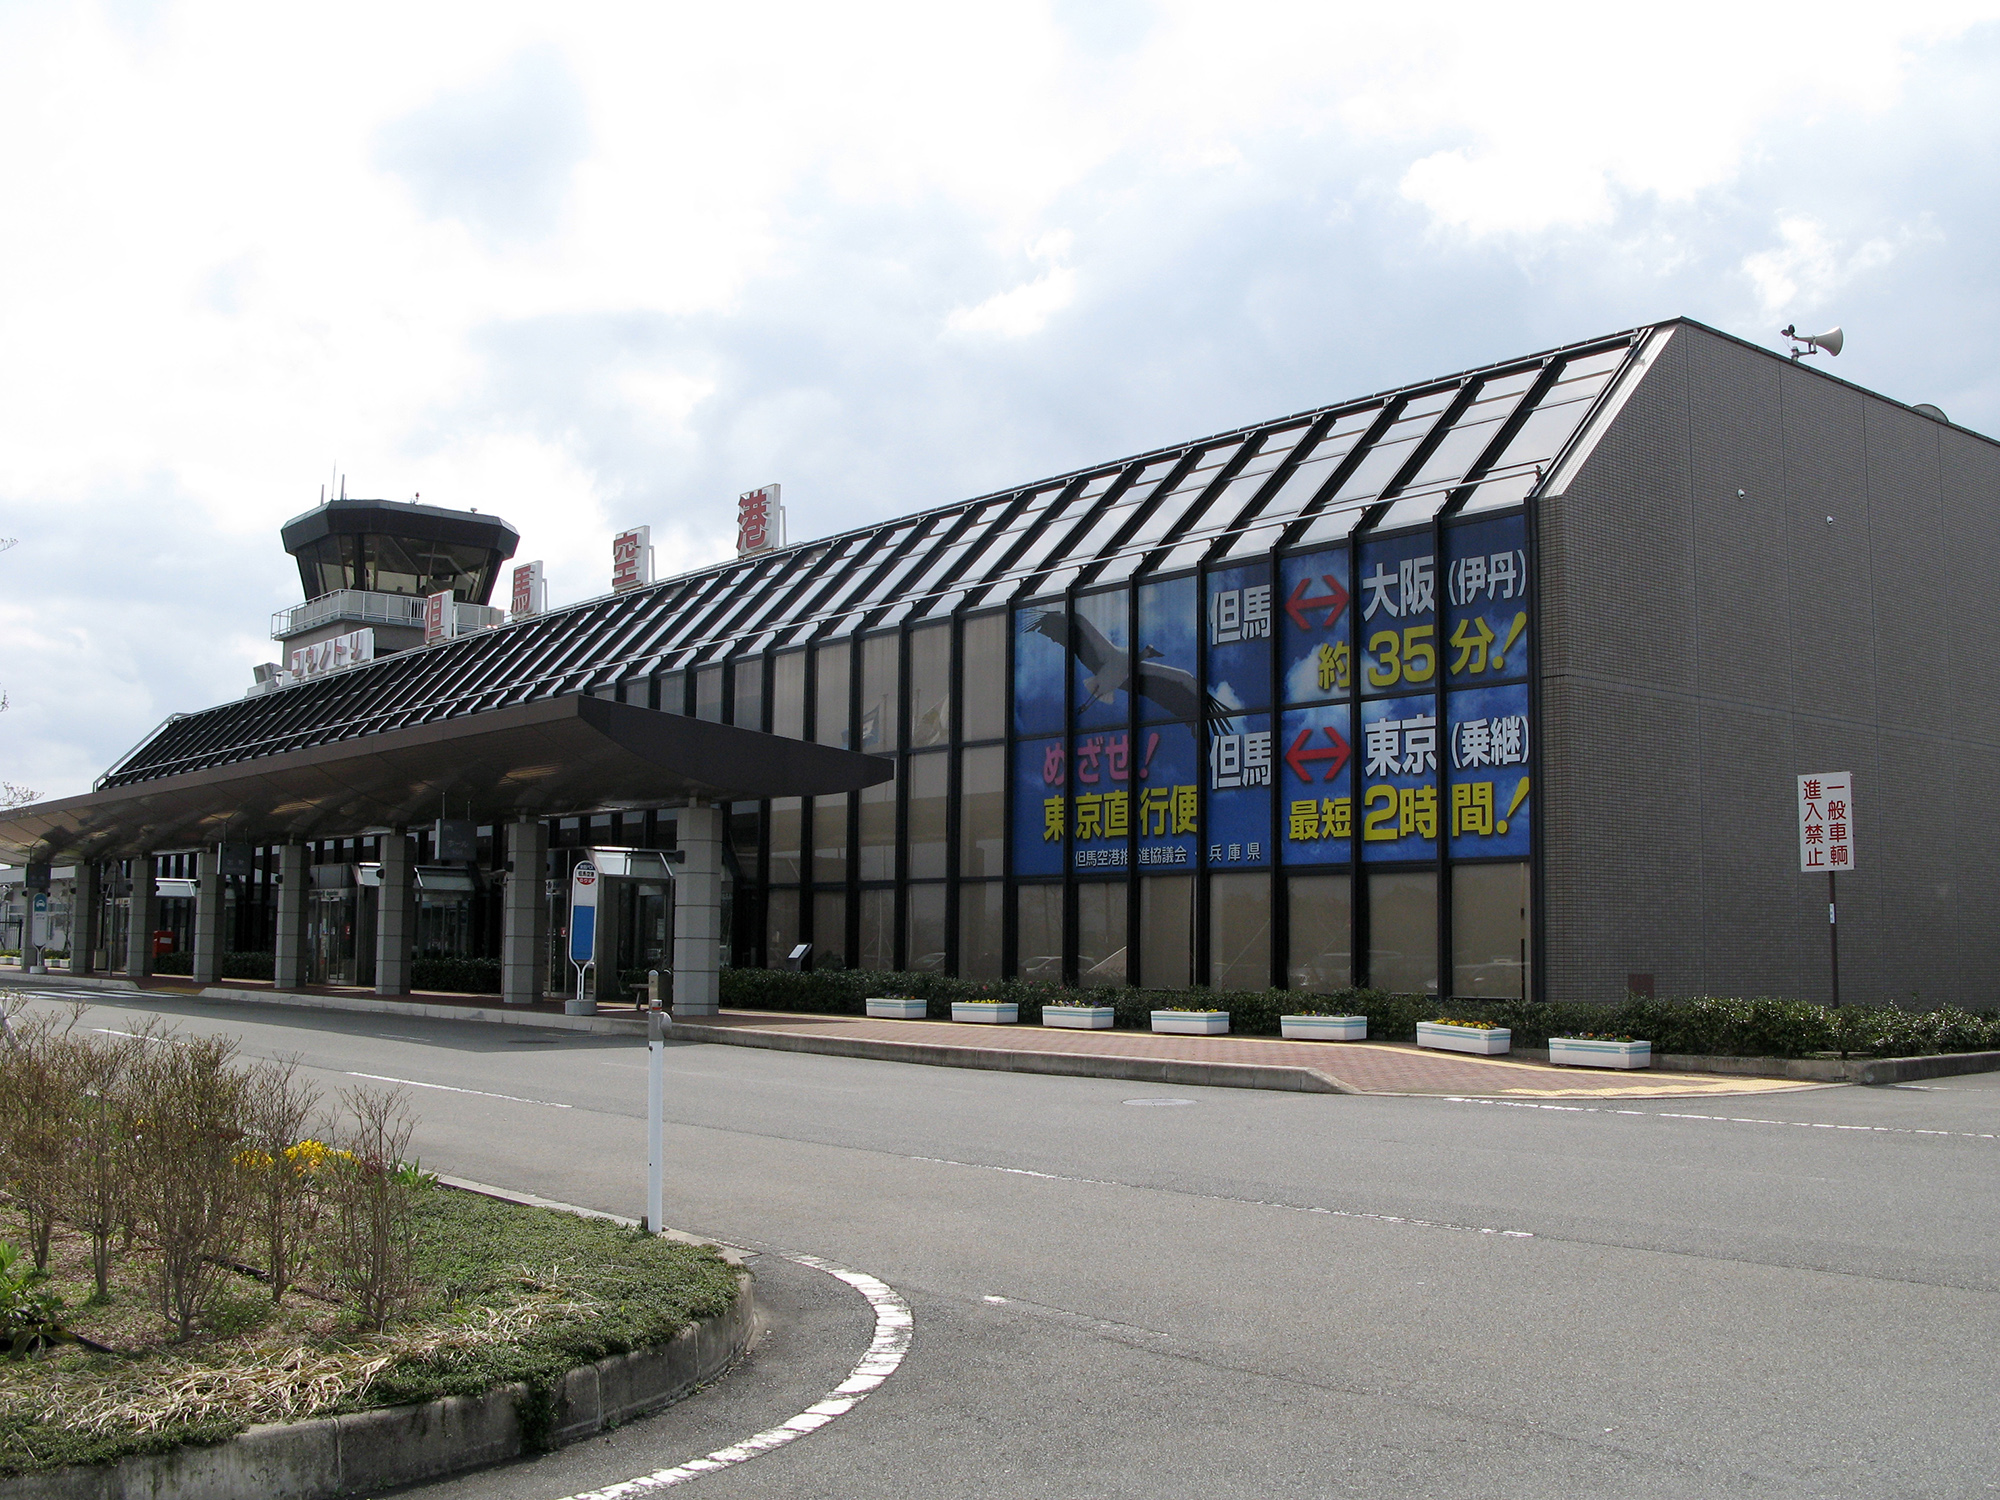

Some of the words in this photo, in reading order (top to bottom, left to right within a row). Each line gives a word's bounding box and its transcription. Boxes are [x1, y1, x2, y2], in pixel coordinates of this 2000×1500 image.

[1210, 584, 1271, 646] 但馬
[292, 631, 363, 677] コウノトリ
[1209, 730, 1271, 790] 但馬
[1043, 784, 1198, 842] 東京直行便
[1803, 779, 1825, 867] 進入禁止
[1209, 842, 1261, 862] 兵庫県
